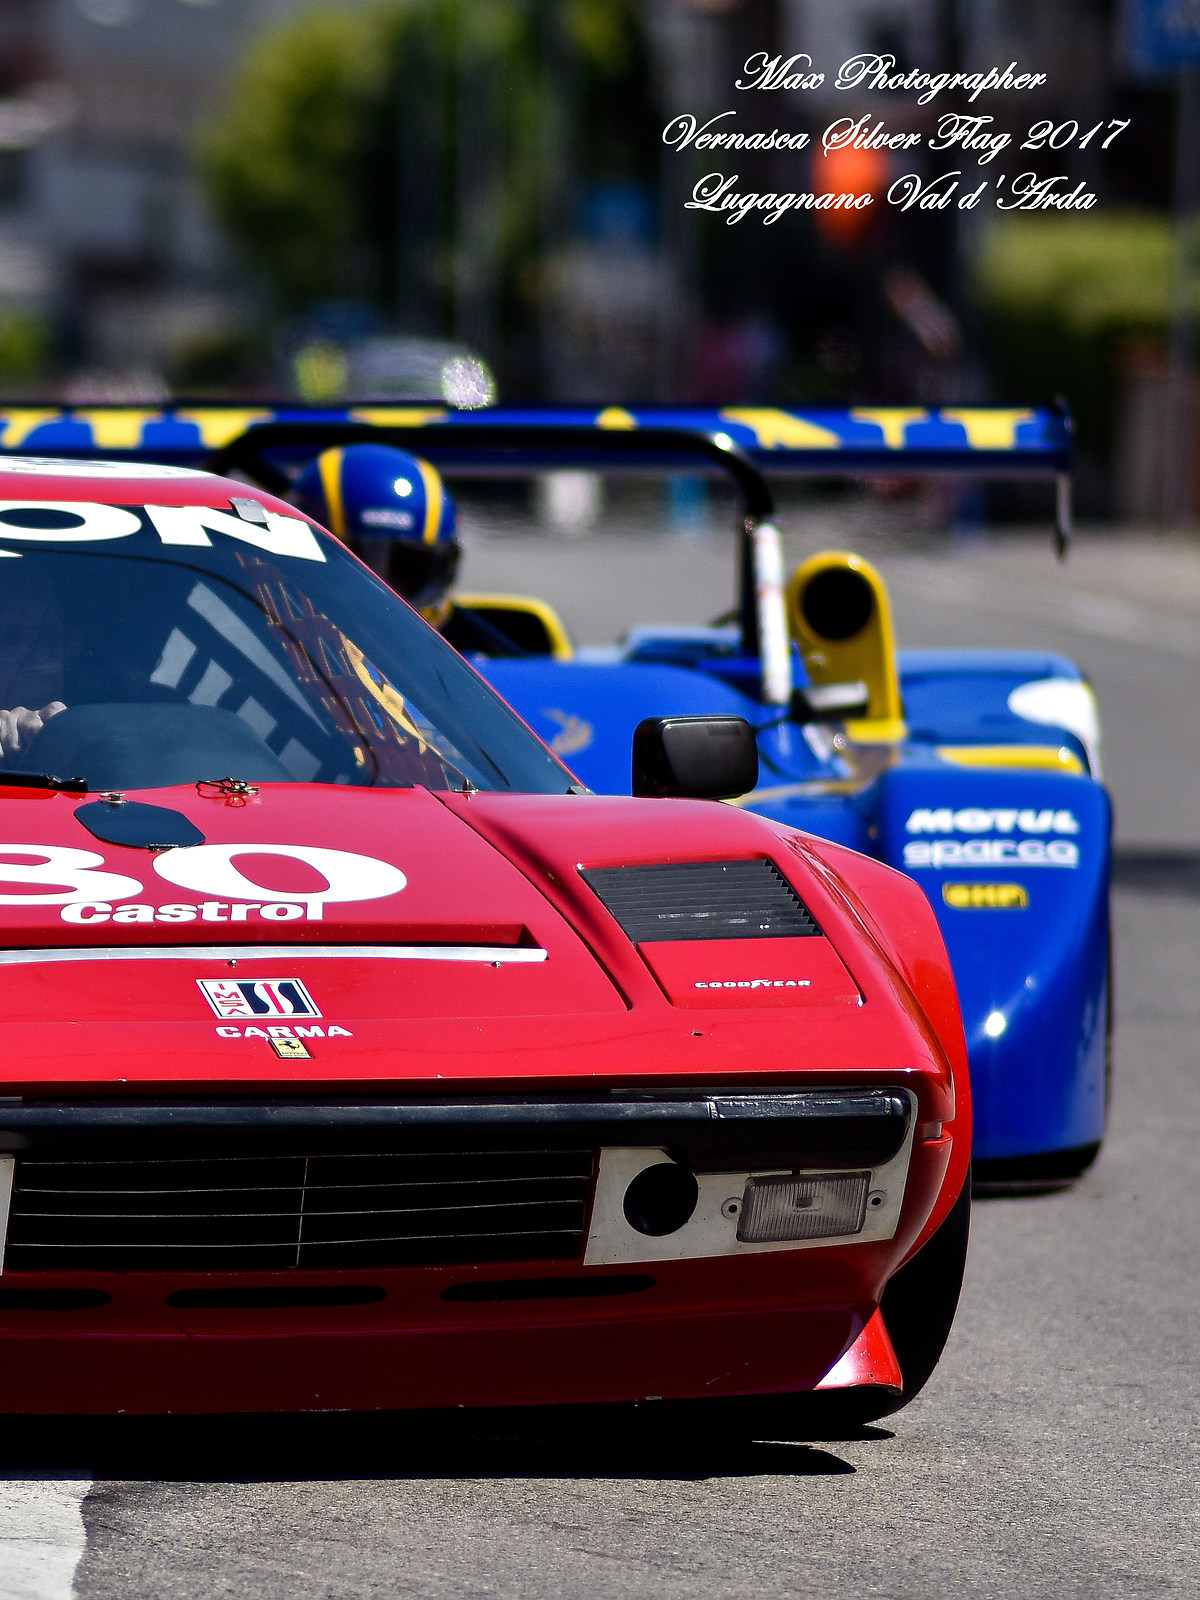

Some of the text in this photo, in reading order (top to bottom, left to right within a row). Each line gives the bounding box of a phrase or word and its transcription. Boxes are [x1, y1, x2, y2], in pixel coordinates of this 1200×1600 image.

[906, 808, 1079, 834] MOTUL
[60, 901, 323, 923] Castrol
[215, 1025, 353, 1038] CARMA
